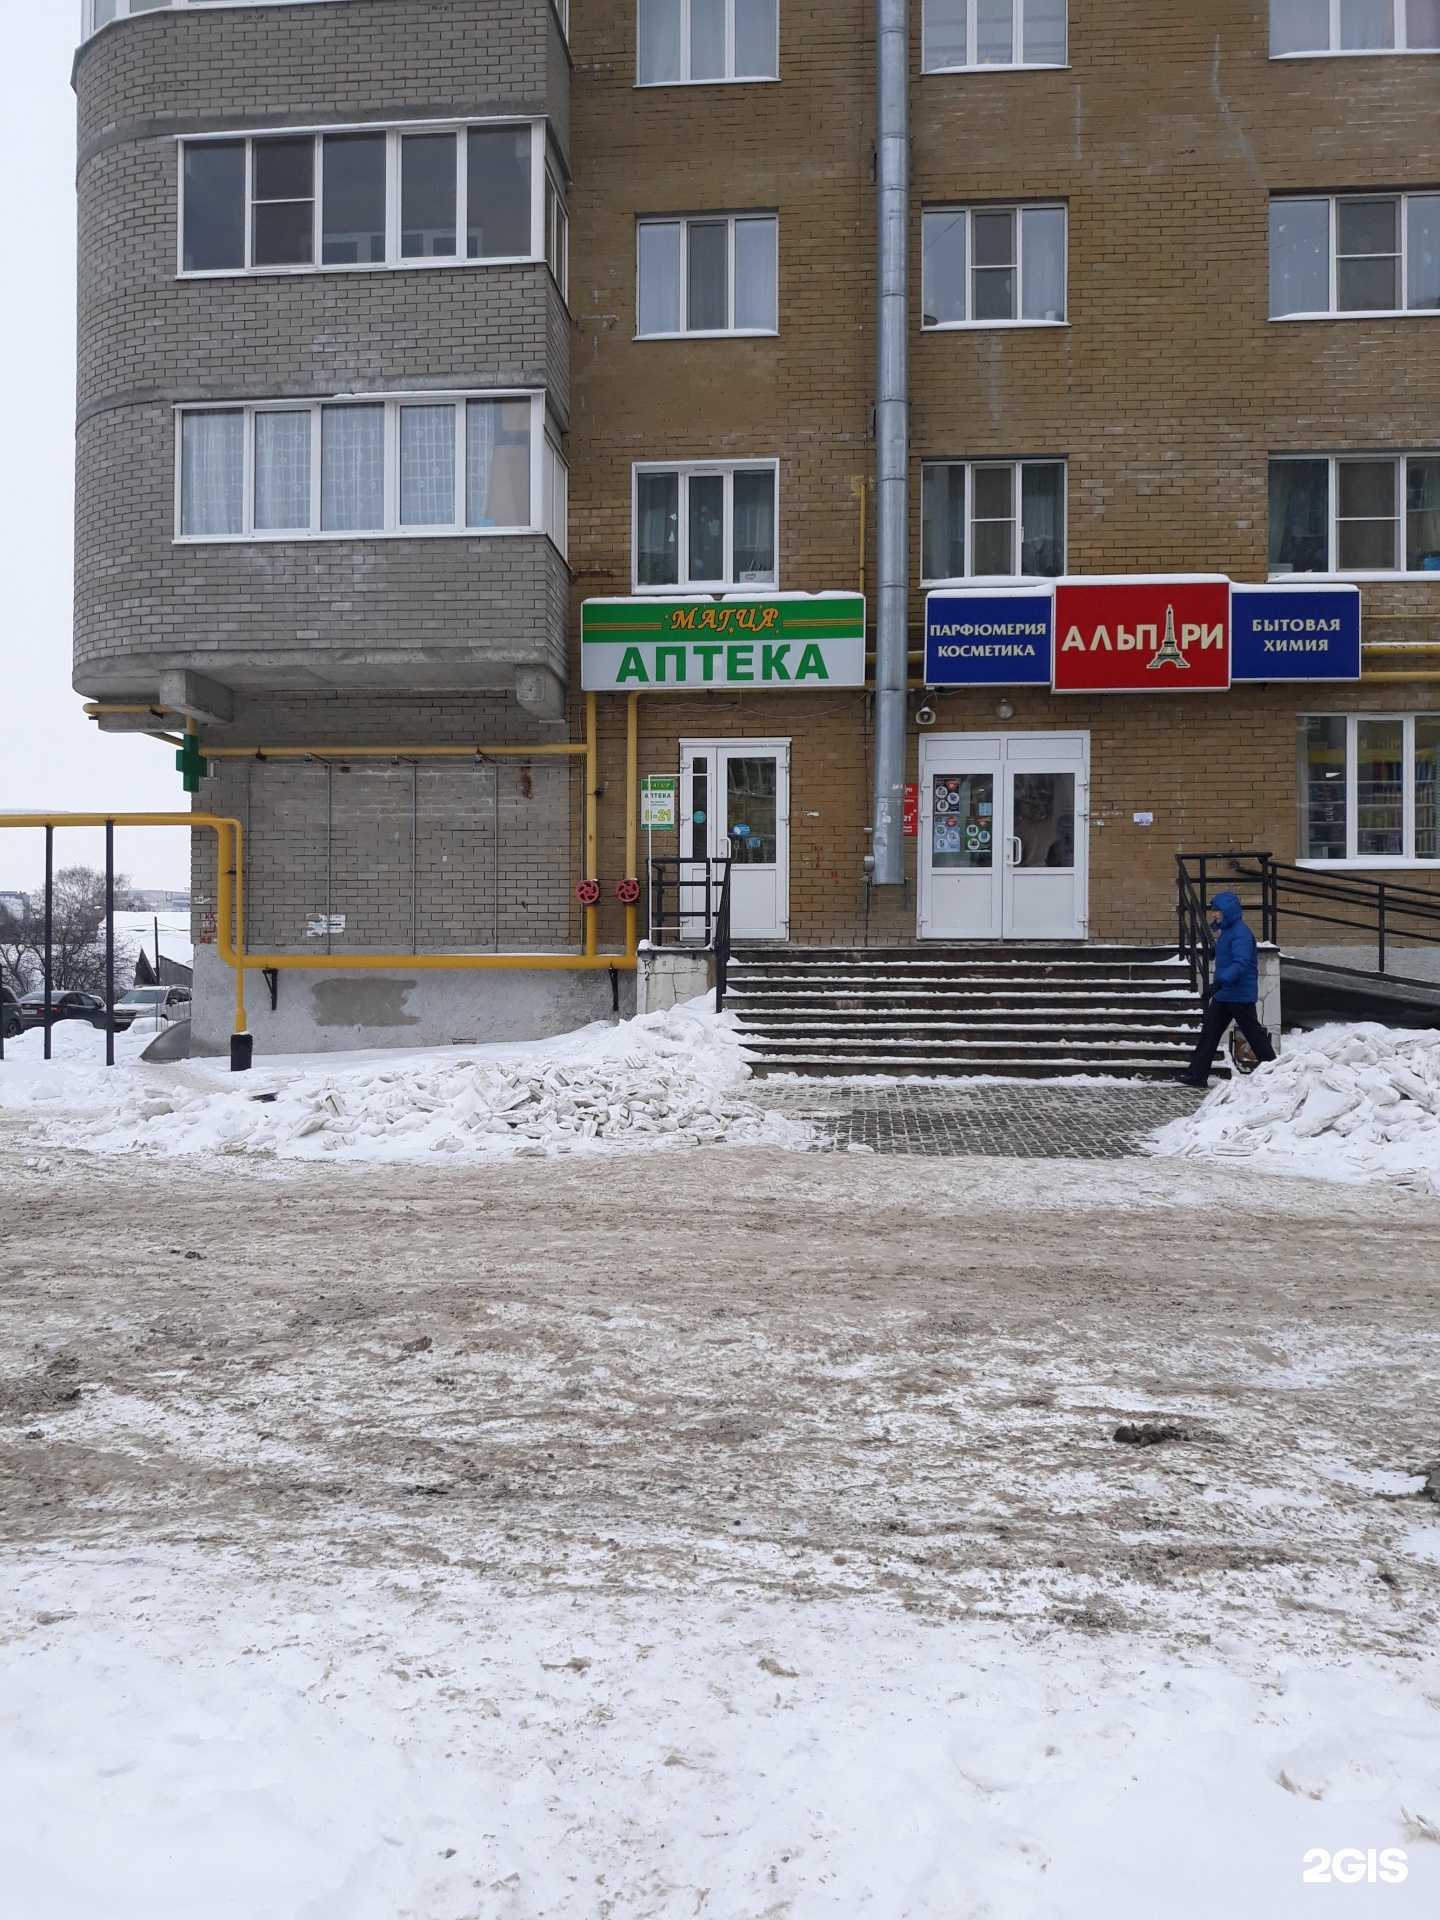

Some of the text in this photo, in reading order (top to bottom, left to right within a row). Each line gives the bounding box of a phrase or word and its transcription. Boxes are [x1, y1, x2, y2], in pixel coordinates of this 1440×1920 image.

[671, 606, 780, 633] МАГИЯ
[1252, 618, 1341, 632] БЫТОВАЯ
[929, 623, 1047, 637] ПАРФЮМЕРИЯ
[937, 644, 1036, 657] КОСМЕТИКА
[1263, 639, 1329, 652] ХИМИЯ
[615, 643, 830, 683] АПТЕКА
